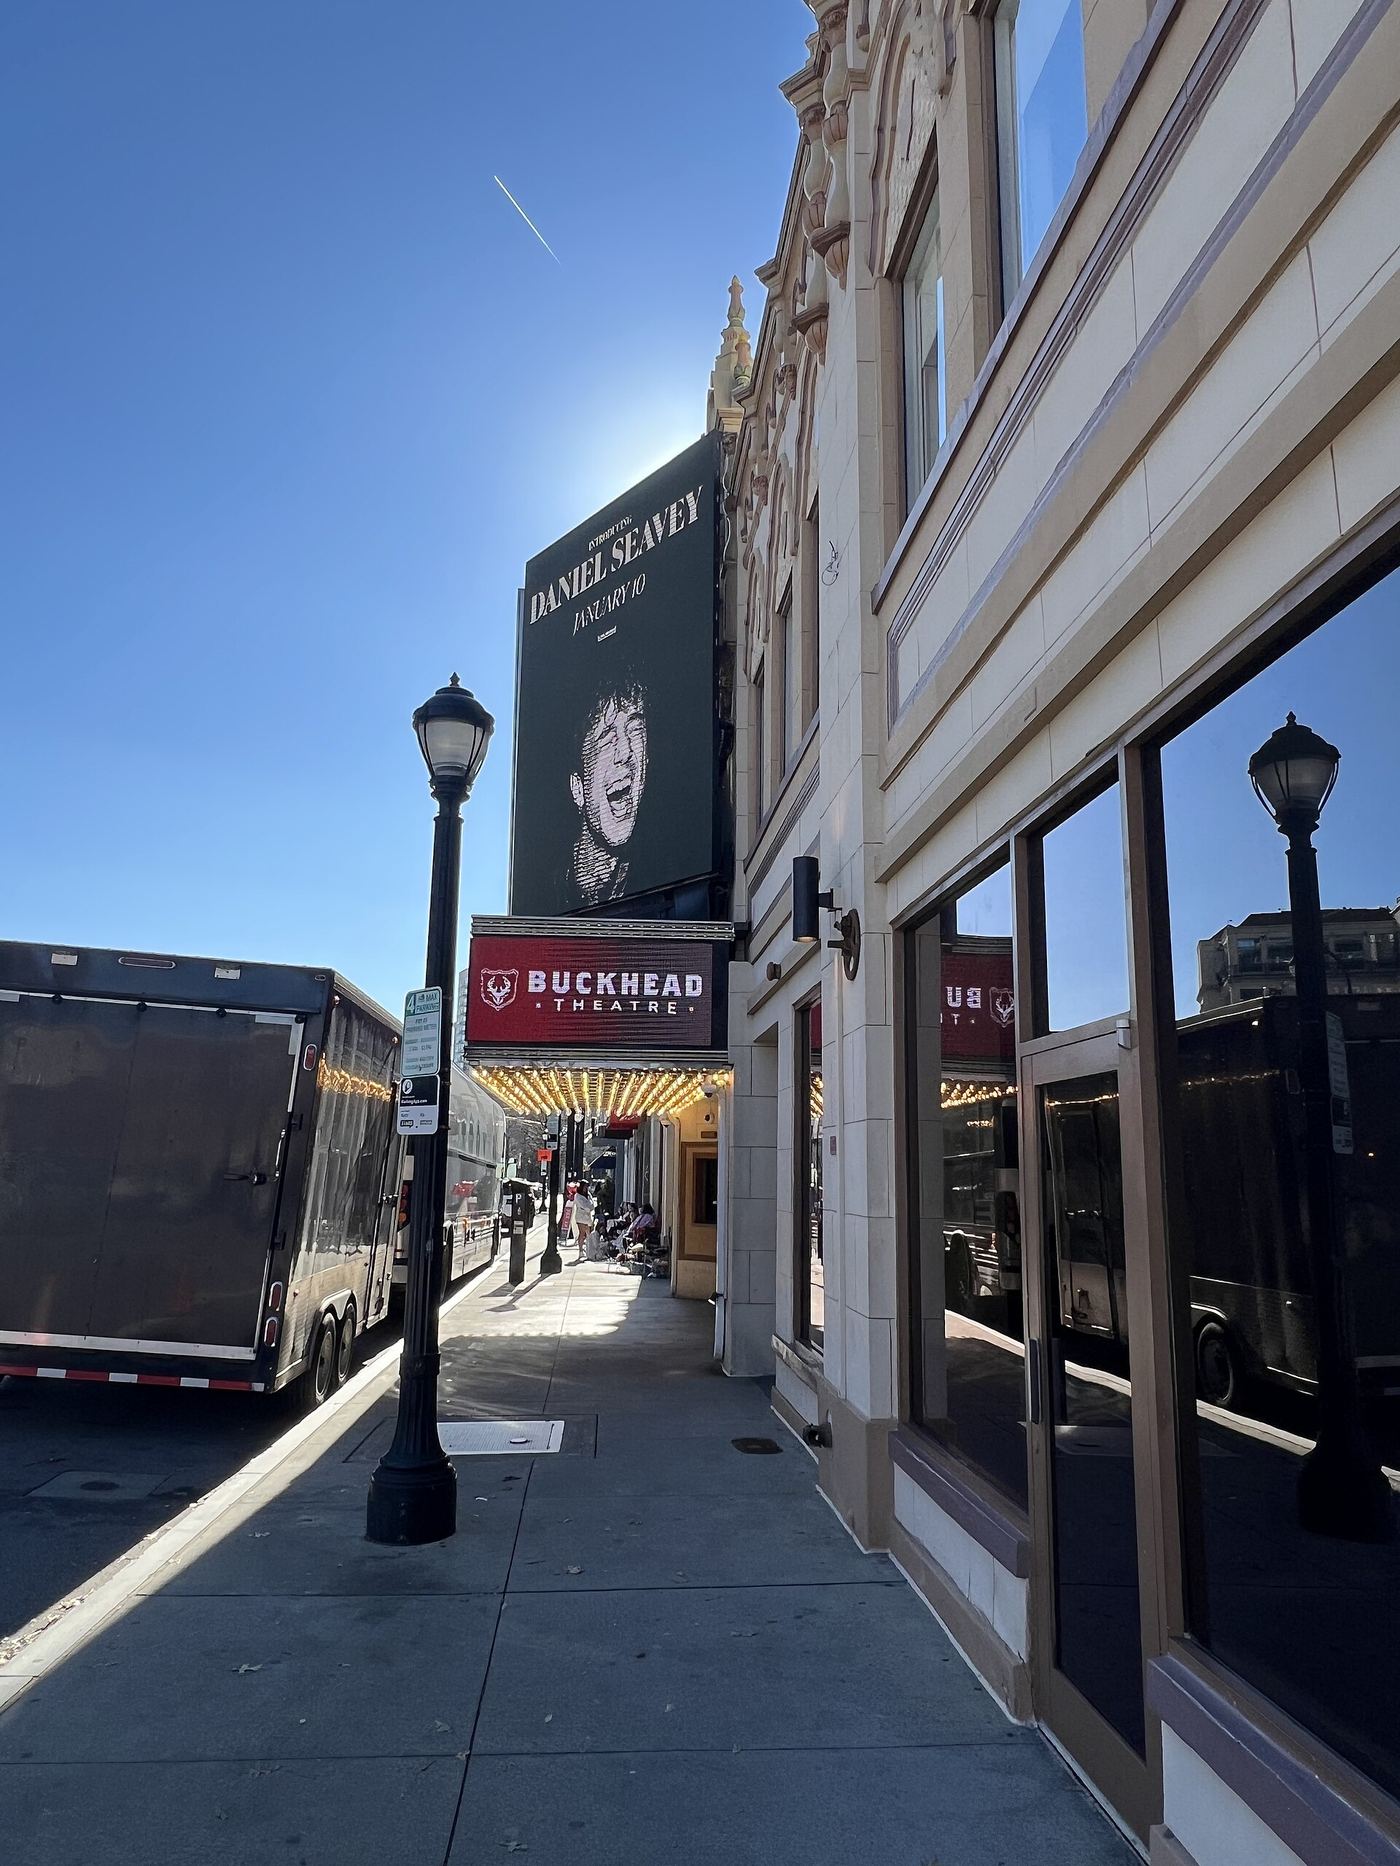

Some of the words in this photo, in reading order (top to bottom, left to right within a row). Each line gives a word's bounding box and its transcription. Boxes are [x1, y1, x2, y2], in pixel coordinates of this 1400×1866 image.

[529, 551, 607, 625] DANIEL
[610, 485, 703, 572] SEAVEY
[573, 580, 631, 636] JANUARY
[631, 573, 647, 598] 10
[527, 970, 704, 997] BUCKHEAD
[407, 994, 416, 1013] 4
[553, 998, 678, 1015] THEATRE
